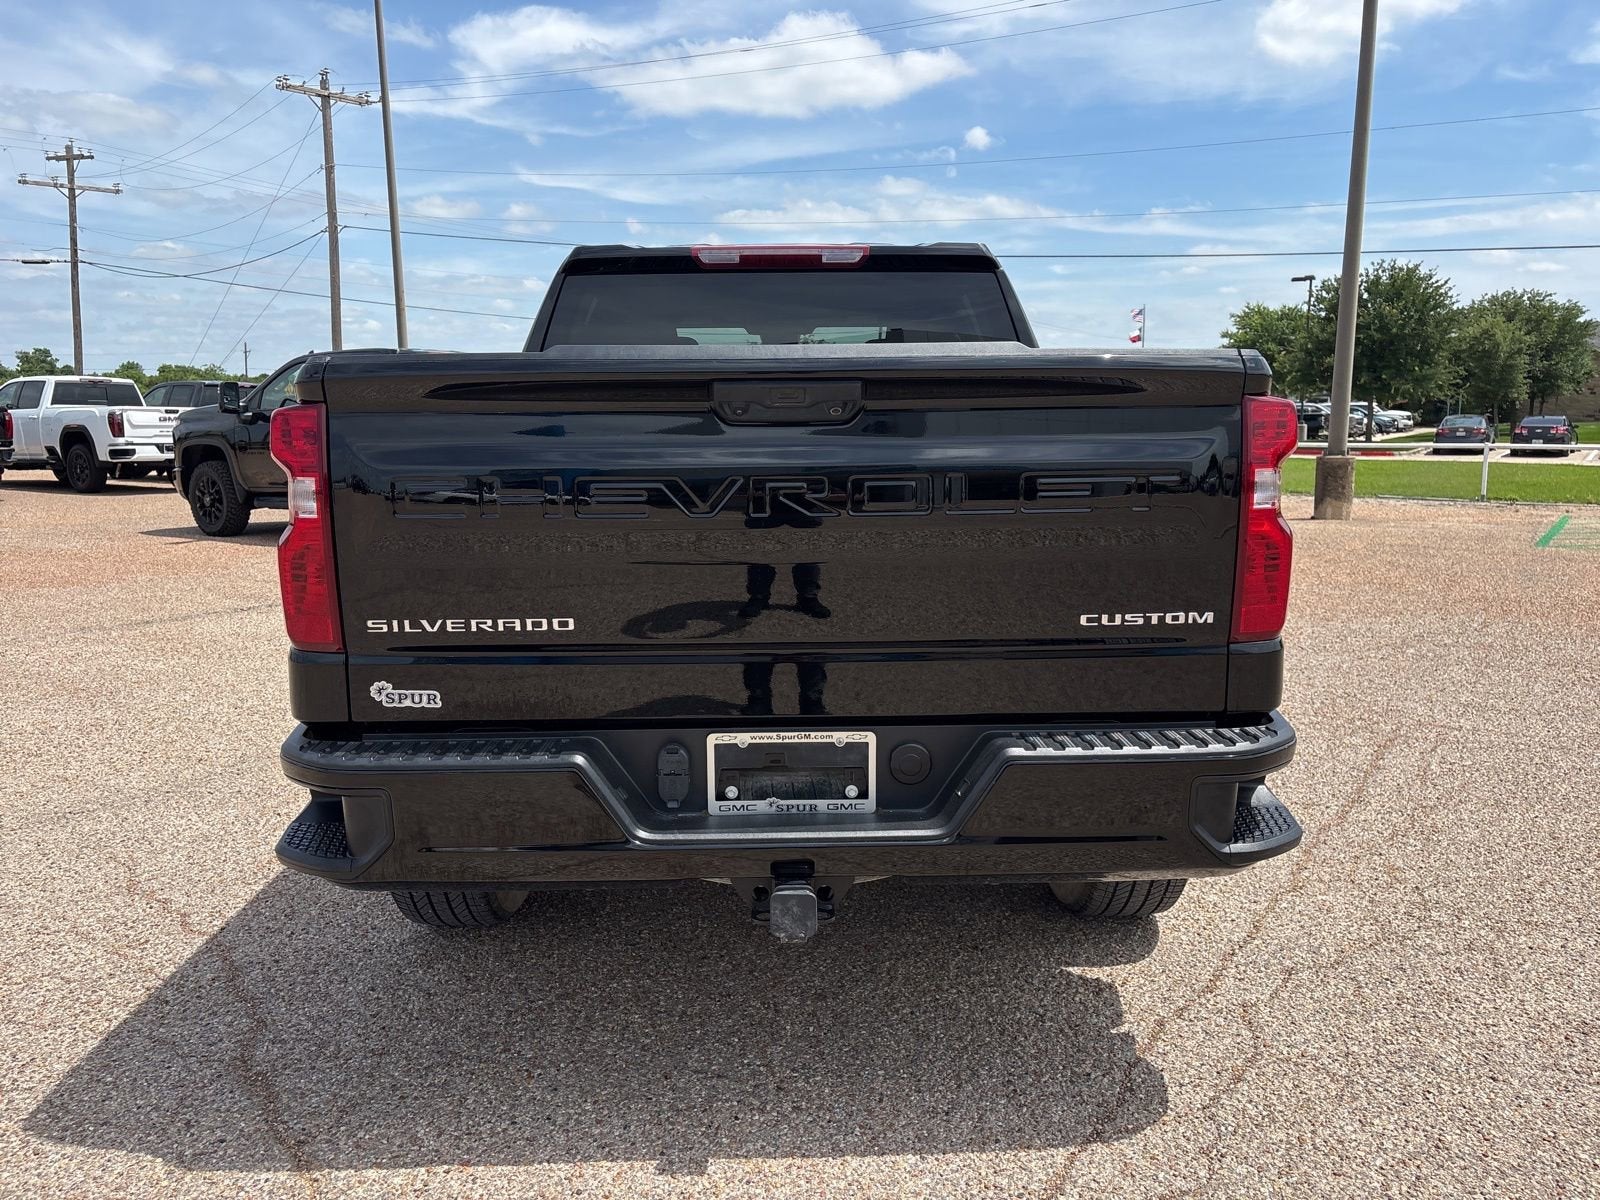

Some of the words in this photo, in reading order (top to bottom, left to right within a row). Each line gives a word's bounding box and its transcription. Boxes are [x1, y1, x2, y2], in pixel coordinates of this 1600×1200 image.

[390, 472, 1184, 520] CHEVROLET
[366, 617, 575, 632] SILVERADO
[1079, 611, 1215, 626] CUSTOM
[385, 692, 439, 705] SPUR
[750, 733, 834, 741] www.SpurGM.com
[718, 803, 758, 813] GMC
[776, 803, 818, 812] SPUR
[826, 802, 867, 811] GMC
